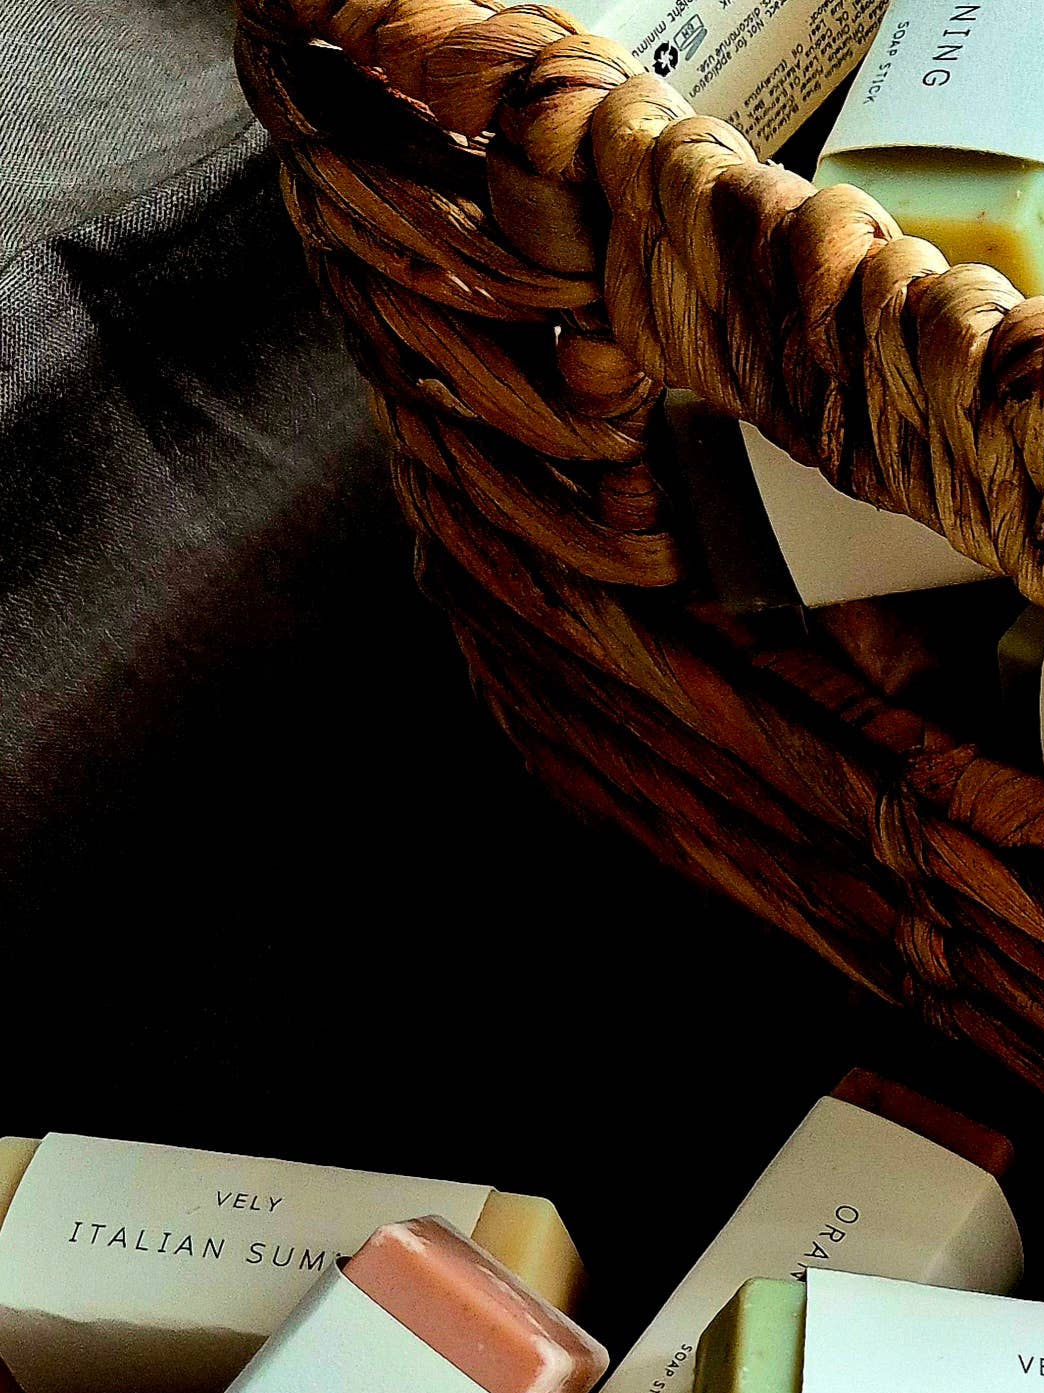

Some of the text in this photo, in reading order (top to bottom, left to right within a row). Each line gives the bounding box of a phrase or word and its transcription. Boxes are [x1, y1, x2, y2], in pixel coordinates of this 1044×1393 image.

[887, 21, 909, 56] SOAP
[863, 62, 891, 104] STICK
[217, 1191, 282, 1212] VELY
[69, 1222, 343, 1272] ITALIAN SUM
[665, 1344, 692, 1377] SOAP
